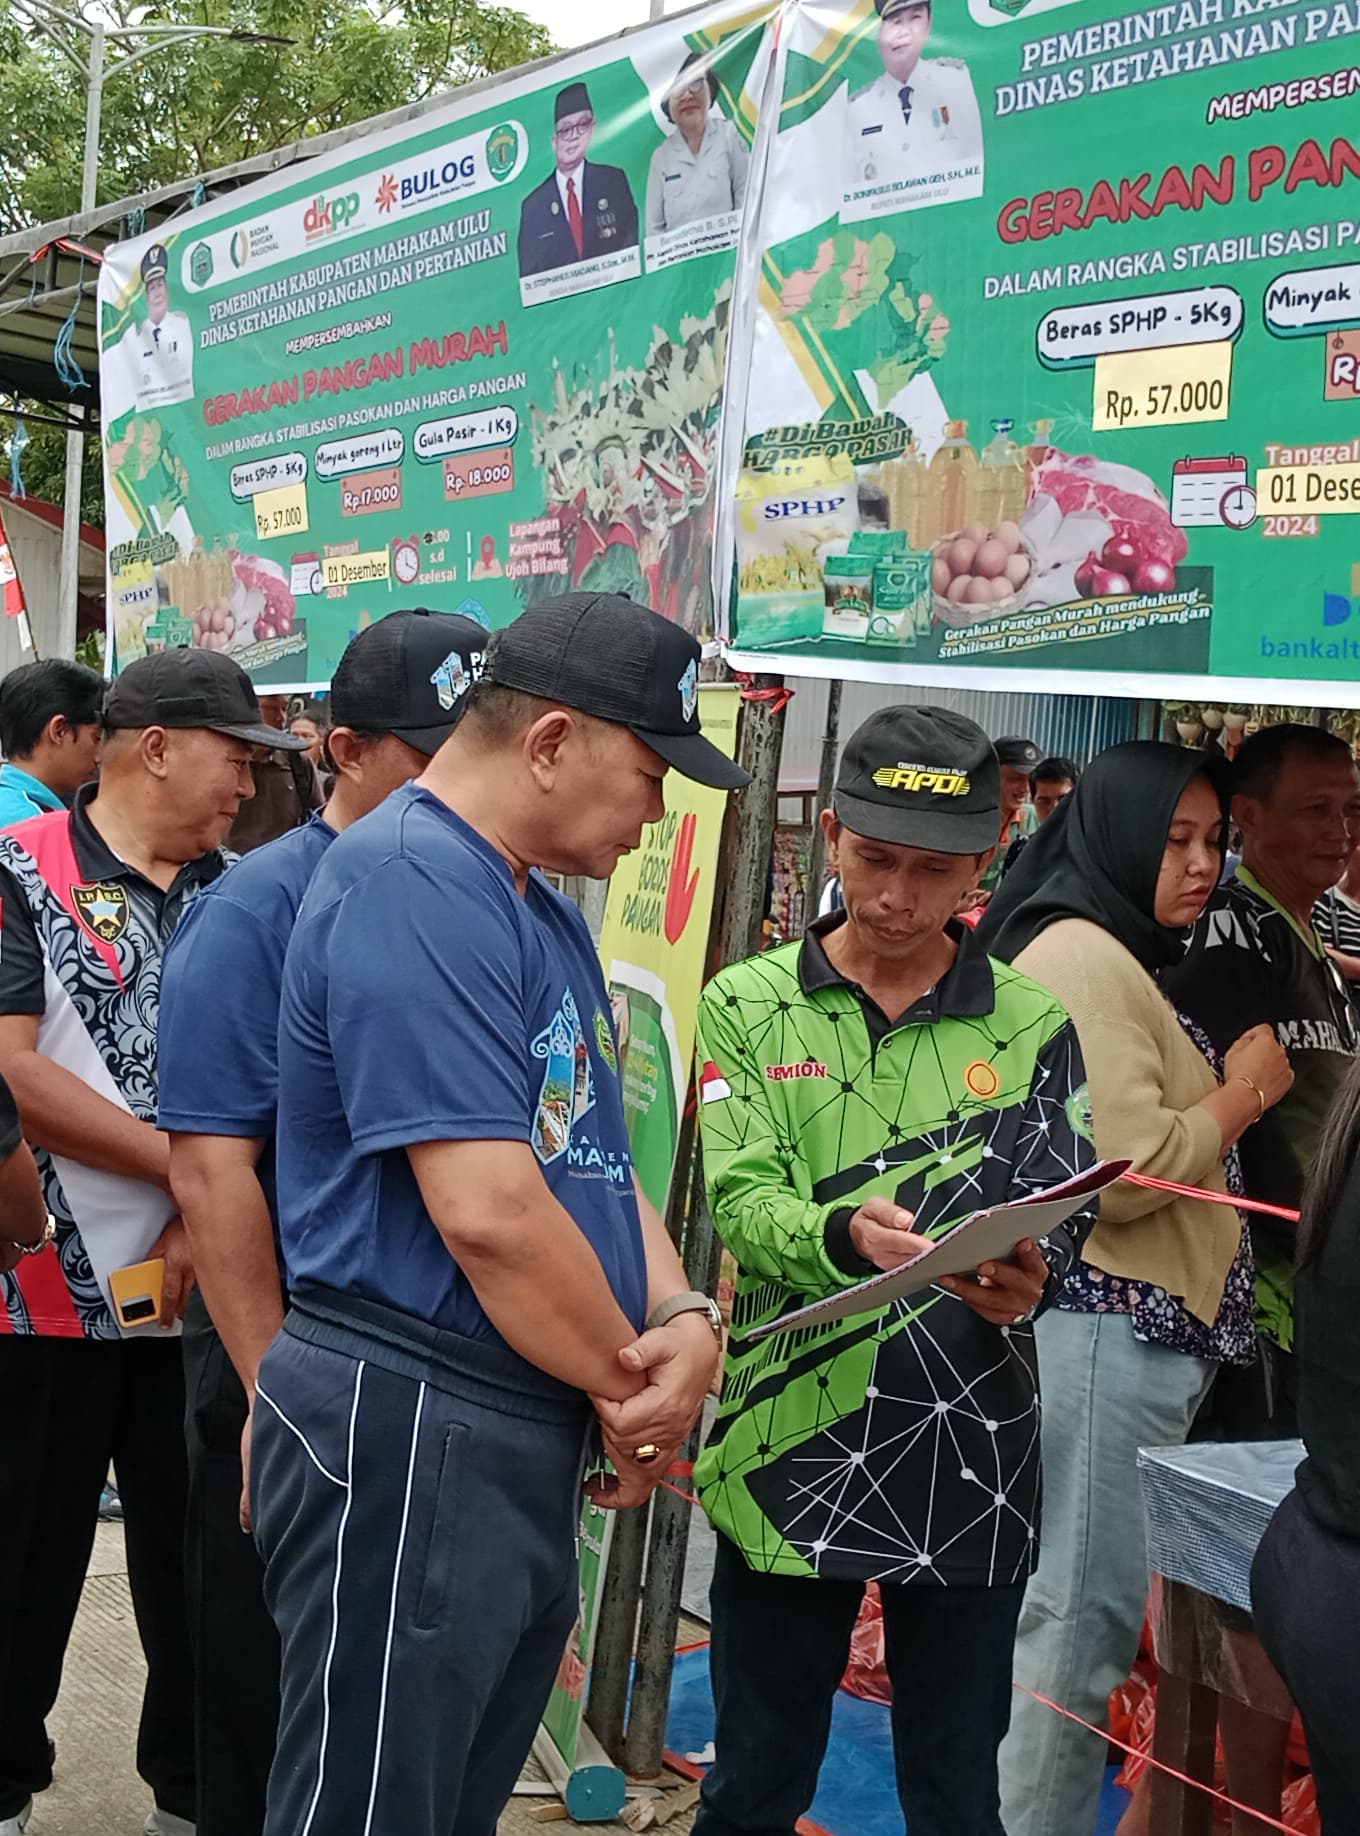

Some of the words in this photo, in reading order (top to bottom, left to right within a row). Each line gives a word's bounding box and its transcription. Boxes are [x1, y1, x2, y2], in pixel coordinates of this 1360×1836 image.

[1021, 0, 1223, 72] PEMERINTAH
[994, 69, 1083, 118] DINAS
[1089, 19, 1296, 97] KETAHANAN
[401, 155, 475, 200] BULOG
[303, 191, 360, 231] dkpp
[996, 154, 1235, 246] GERAKAN
[209, 280, 288, 323] PEMERINTAH
[289, 251, 372, 295] KABUPATEN
[373, 224, 457, 269] MAHAKAM
[459, 208, 491, 241] ULU
[984, 260, 1064, 301] DALAM
[1067, 251, 1168, 288] RANGKA
[1172, 228, 1329, 274] STABILISASI
[199, 322, 237, 349] DINAS
[237, 297, 317, 339] KETAHANAN
[317, 276, 376, 314] PANGAN
[378, 265, 412, 295] DAN
[413, 231, 508, 281] PERTANIAN
[1268, 281, 1351, 312] Minyak
[285, 311, 392, 356] MEMPERSEMBAHKAN
[1046, 319, 1103, 343] Beras
[1108, 304, 1168, 334] SPHP
[1189, 300, 1233, 328] 5Kg
[202, 377, 299, 428] GERAKAN
[303, 346, 405, 402] PANGAN
[409, 320, 509, 376] MURAH
[205, 440, 235, 461] DALAM
[234, 431, 275, 456] RANGKA
[276, 415, 338, 448] STABILISASI
[338, 401, 392, 433] PASOKAN
[394, 397, 421, 417] DAN
[422, 383, 467, 411] HARGA
[469, 371, 526, 403] PANGAN
[1106, 388, 1140, 426] Rp.
[1145, 379, 1224, 417] 57.000
[419, 431, 444, 449] Gula
[446, 425, 477, 443] Pasir
[496, 417, 513, 435] Kg
[816, 411, 896, 441] Bawah
[845, 427, 913, 459] PASAR
[350, 445, 380, 462] goreng
[387, 437, 402, 452] Ltr
[467, 463, 512, 488] 18.000
[1270, 475, 1297, 503] 01
[257, 513, 272, 537] Rp.
[273, 506, 302, 530] 57.000
[508, 517, 561, 538] Lapangan
[763, 497, 846, 521] SPHP
[1263, 514, 1318, 538] 2024
[328, 564, 340, 583] 01
[341, 560, 389, 581] Desember
[429, 548, 445, 564] s.d
[418, 566, 458, 585] selesai
[505, 561, 530, 579] Ujoh
[530, 556, 569, 578] Bilang
[937, 637, 1007, 660] Stabilisasi
[1007, 630, 1068, 649] Pasokan
[1068, 623, 1097, 638] dan
[1098, 616, 1146, 636] Harga
[1148, 606, 1211, 627] Pangan
[944, 621, 999, 642] Gerakan
[999, 614, 1052, 634] Pangan
[1052, 604, 1103, 625] Murah
[766, 1063, 826, 1081] SEMION
